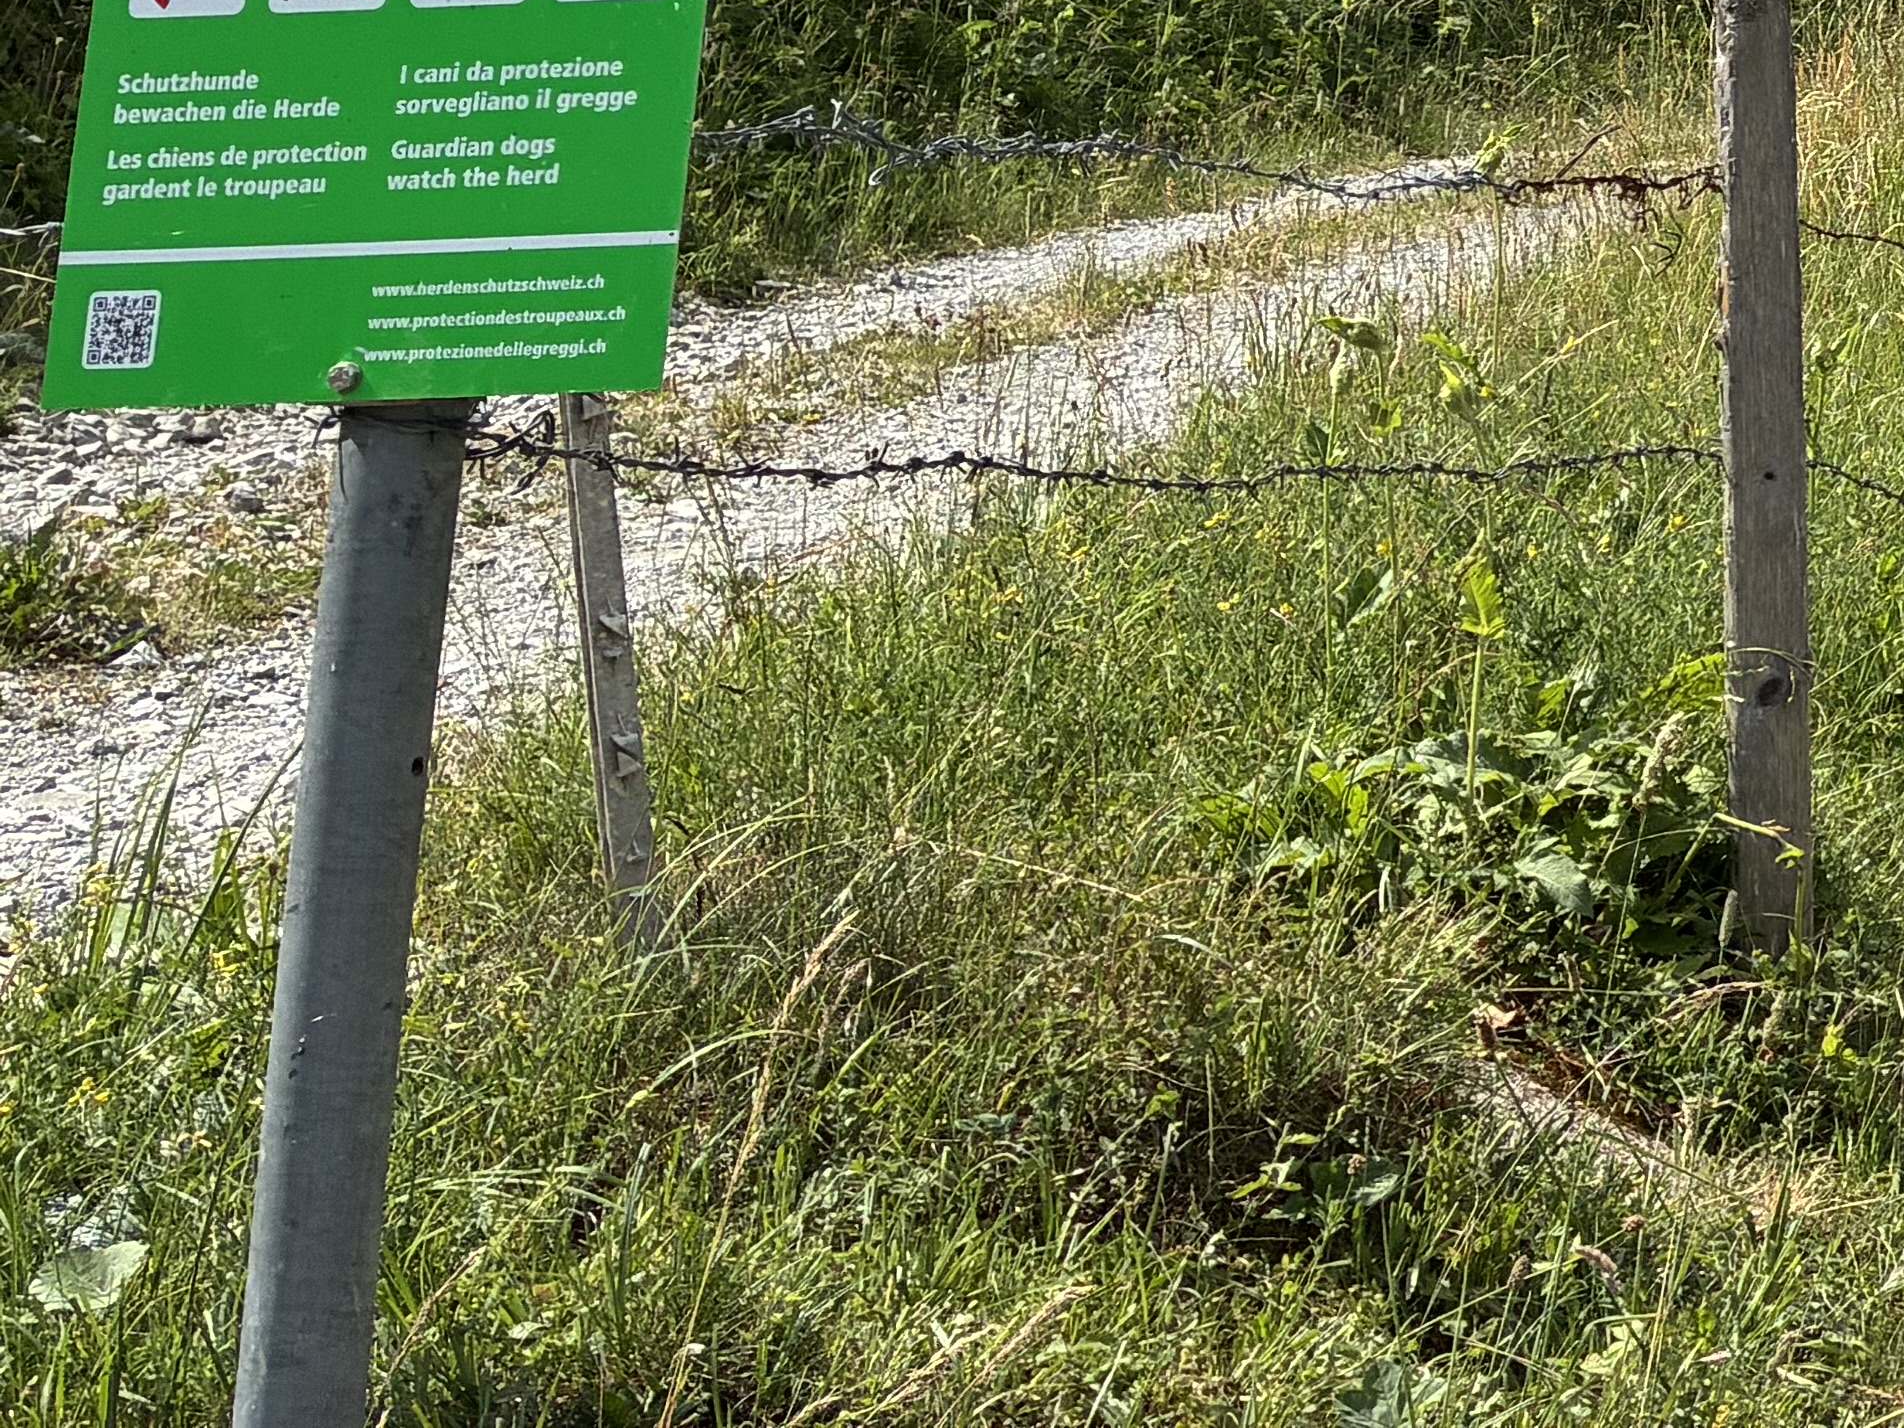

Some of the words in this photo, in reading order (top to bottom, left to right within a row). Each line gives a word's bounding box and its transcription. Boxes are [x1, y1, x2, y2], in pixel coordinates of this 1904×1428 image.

[117, 68, 259, 94] Schutzhunde
[400, 65, 408, 85] I
[413, 61, 460, 84] cani
[465, 60, 495, 82] da
[499, 56, 624, 86] protezione
[113, 101, 226, 125] bewachen
[232, 99, 267, 120] die
[273, 96, 341, 119] Herde
[394, 90, 529, 118] sorvegliano
[535, 88, 552, 109] il
[556, 89, 638, 114] gregge
[107, 149, 142, 170] Les
[147, 147, 216, 169] chiens
[220, 144, 248, 166] de
[251, 141, 368, 170] protection
[391, 136, 494, 160] Guardian
[500, 134, 556, 160] dogs
[101, 178, 192, 206] gardent
[196, 176, 218, 197] le
[224, 176, 327, 200] troupeau
[387, 167, 456, 191] watch
[462, 166, 501, 188] the
[506, 162, 560, 186] herd
[371, 274, 605, 297] www.herdenschutzschweiz.ch
[368, 306, 626, 331] www.protectiondestroupeaux.ch
[364, 338, 606, 364] www.protezionedellegreggi.ch
